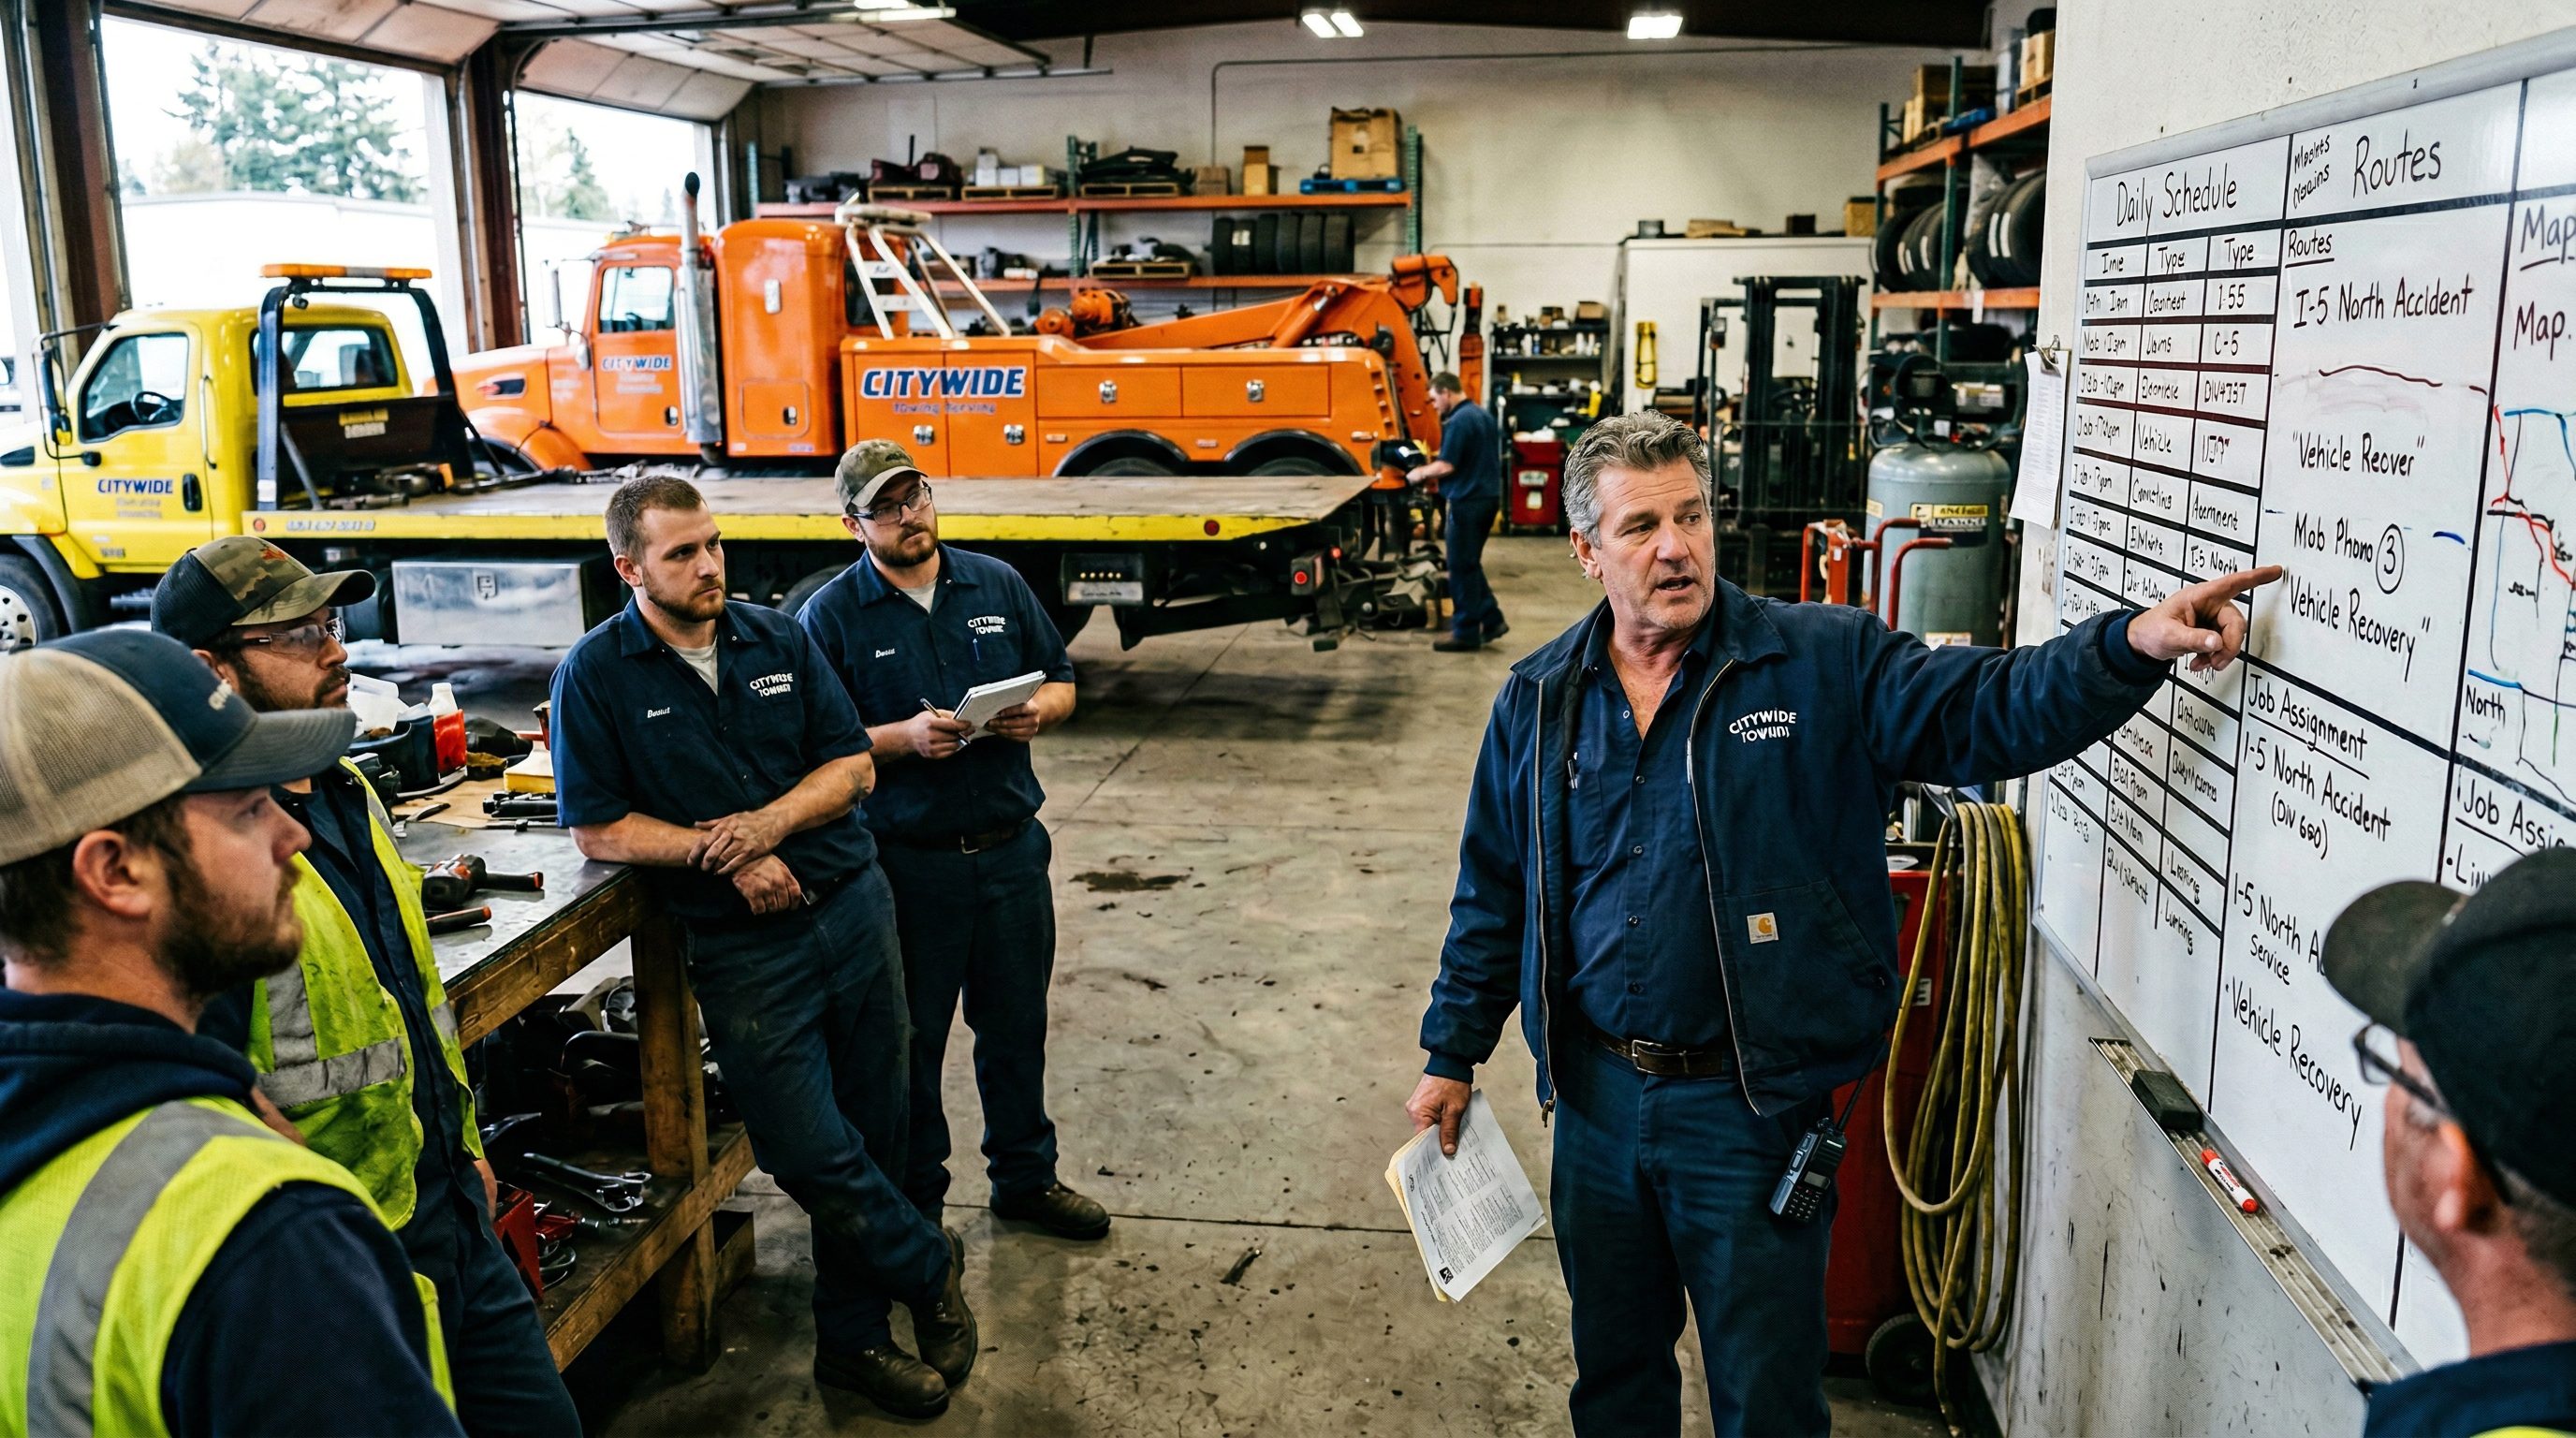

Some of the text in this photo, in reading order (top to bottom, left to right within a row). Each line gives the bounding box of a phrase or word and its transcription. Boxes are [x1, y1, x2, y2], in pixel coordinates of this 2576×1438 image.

[2353, 129, 2441, 198] Routes
[2117, 162, 2237, 238] Daily Schedule
[2158, 245, 2186, 275] Type
[2224, 237, 2254, 271] Type
[2288, 228, 2333, 258] Routes
[2293, 273, 2474, 328] I-5 North Accident
[602, 357, 671, 370] CITYWIDE
[862, 367, 1026, 398] CITYWIDE
[98, 479, 173, 493] CITYWIDE
[2293, 511, 2325, 551] Mob
[1729, 709, 1797, 735] CITYWIDE
[2248, 672, 2275, 714] Job
[2279, 687, 2367, 761] Assignment
[2466, 685, 2505, 727] North
[2275, 744, 2316, 800] North
[2321, 771, 2392, 842] Accident
[2464, 778, 2500, 825] Job
[2260, 895, 2302, 955] North
[2249, 932, 2291, 985] Service
[2232, 976, 2363, 1152] Vehicle Recovery
